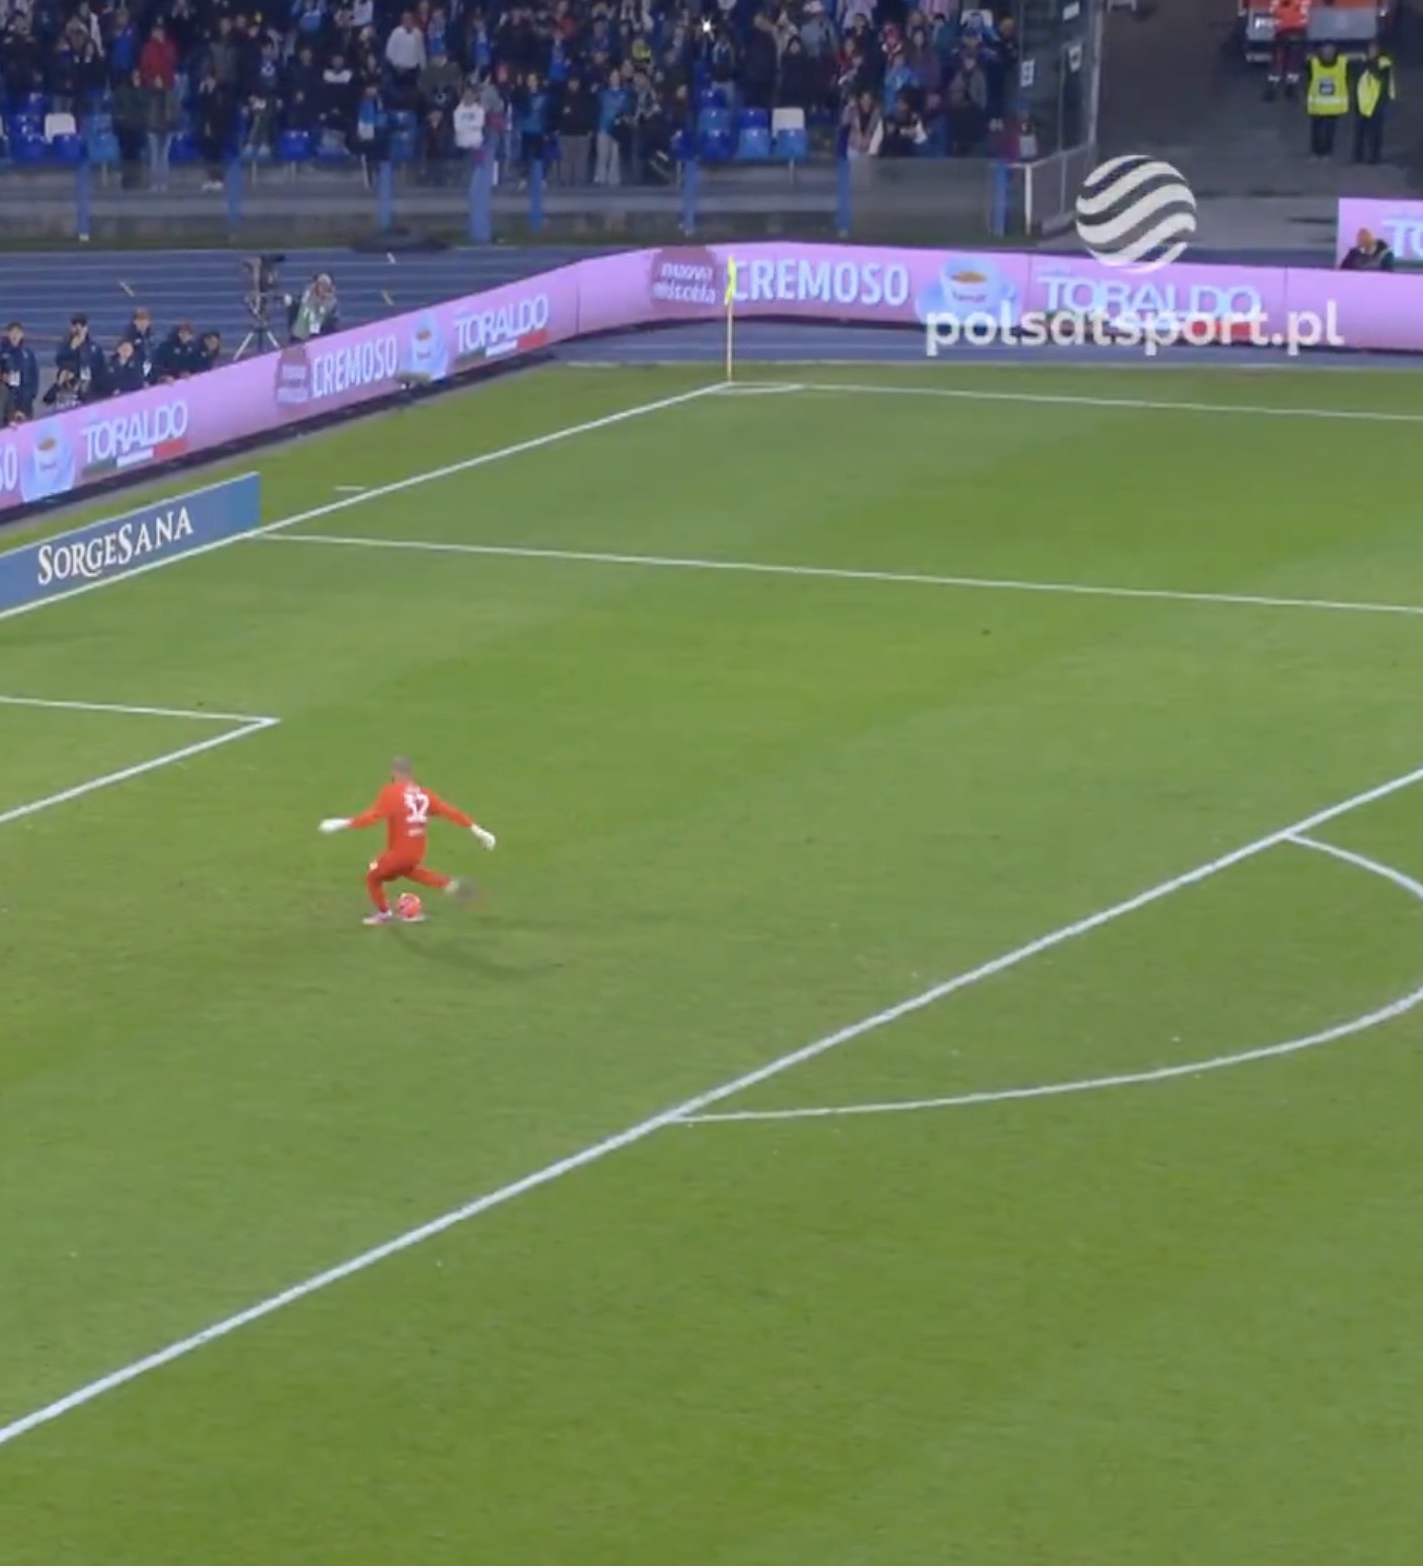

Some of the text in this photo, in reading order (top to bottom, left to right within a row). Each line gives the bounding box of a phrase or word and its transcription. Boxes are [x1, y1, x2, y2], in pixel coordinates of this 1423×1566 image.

[730, 259, 909, 305] CREMOSO
[311, 335, 398, 399] CREMOSO
[454, 295, 549, 352] TORALDO
[83, 401, 188, 463] TORALDO
